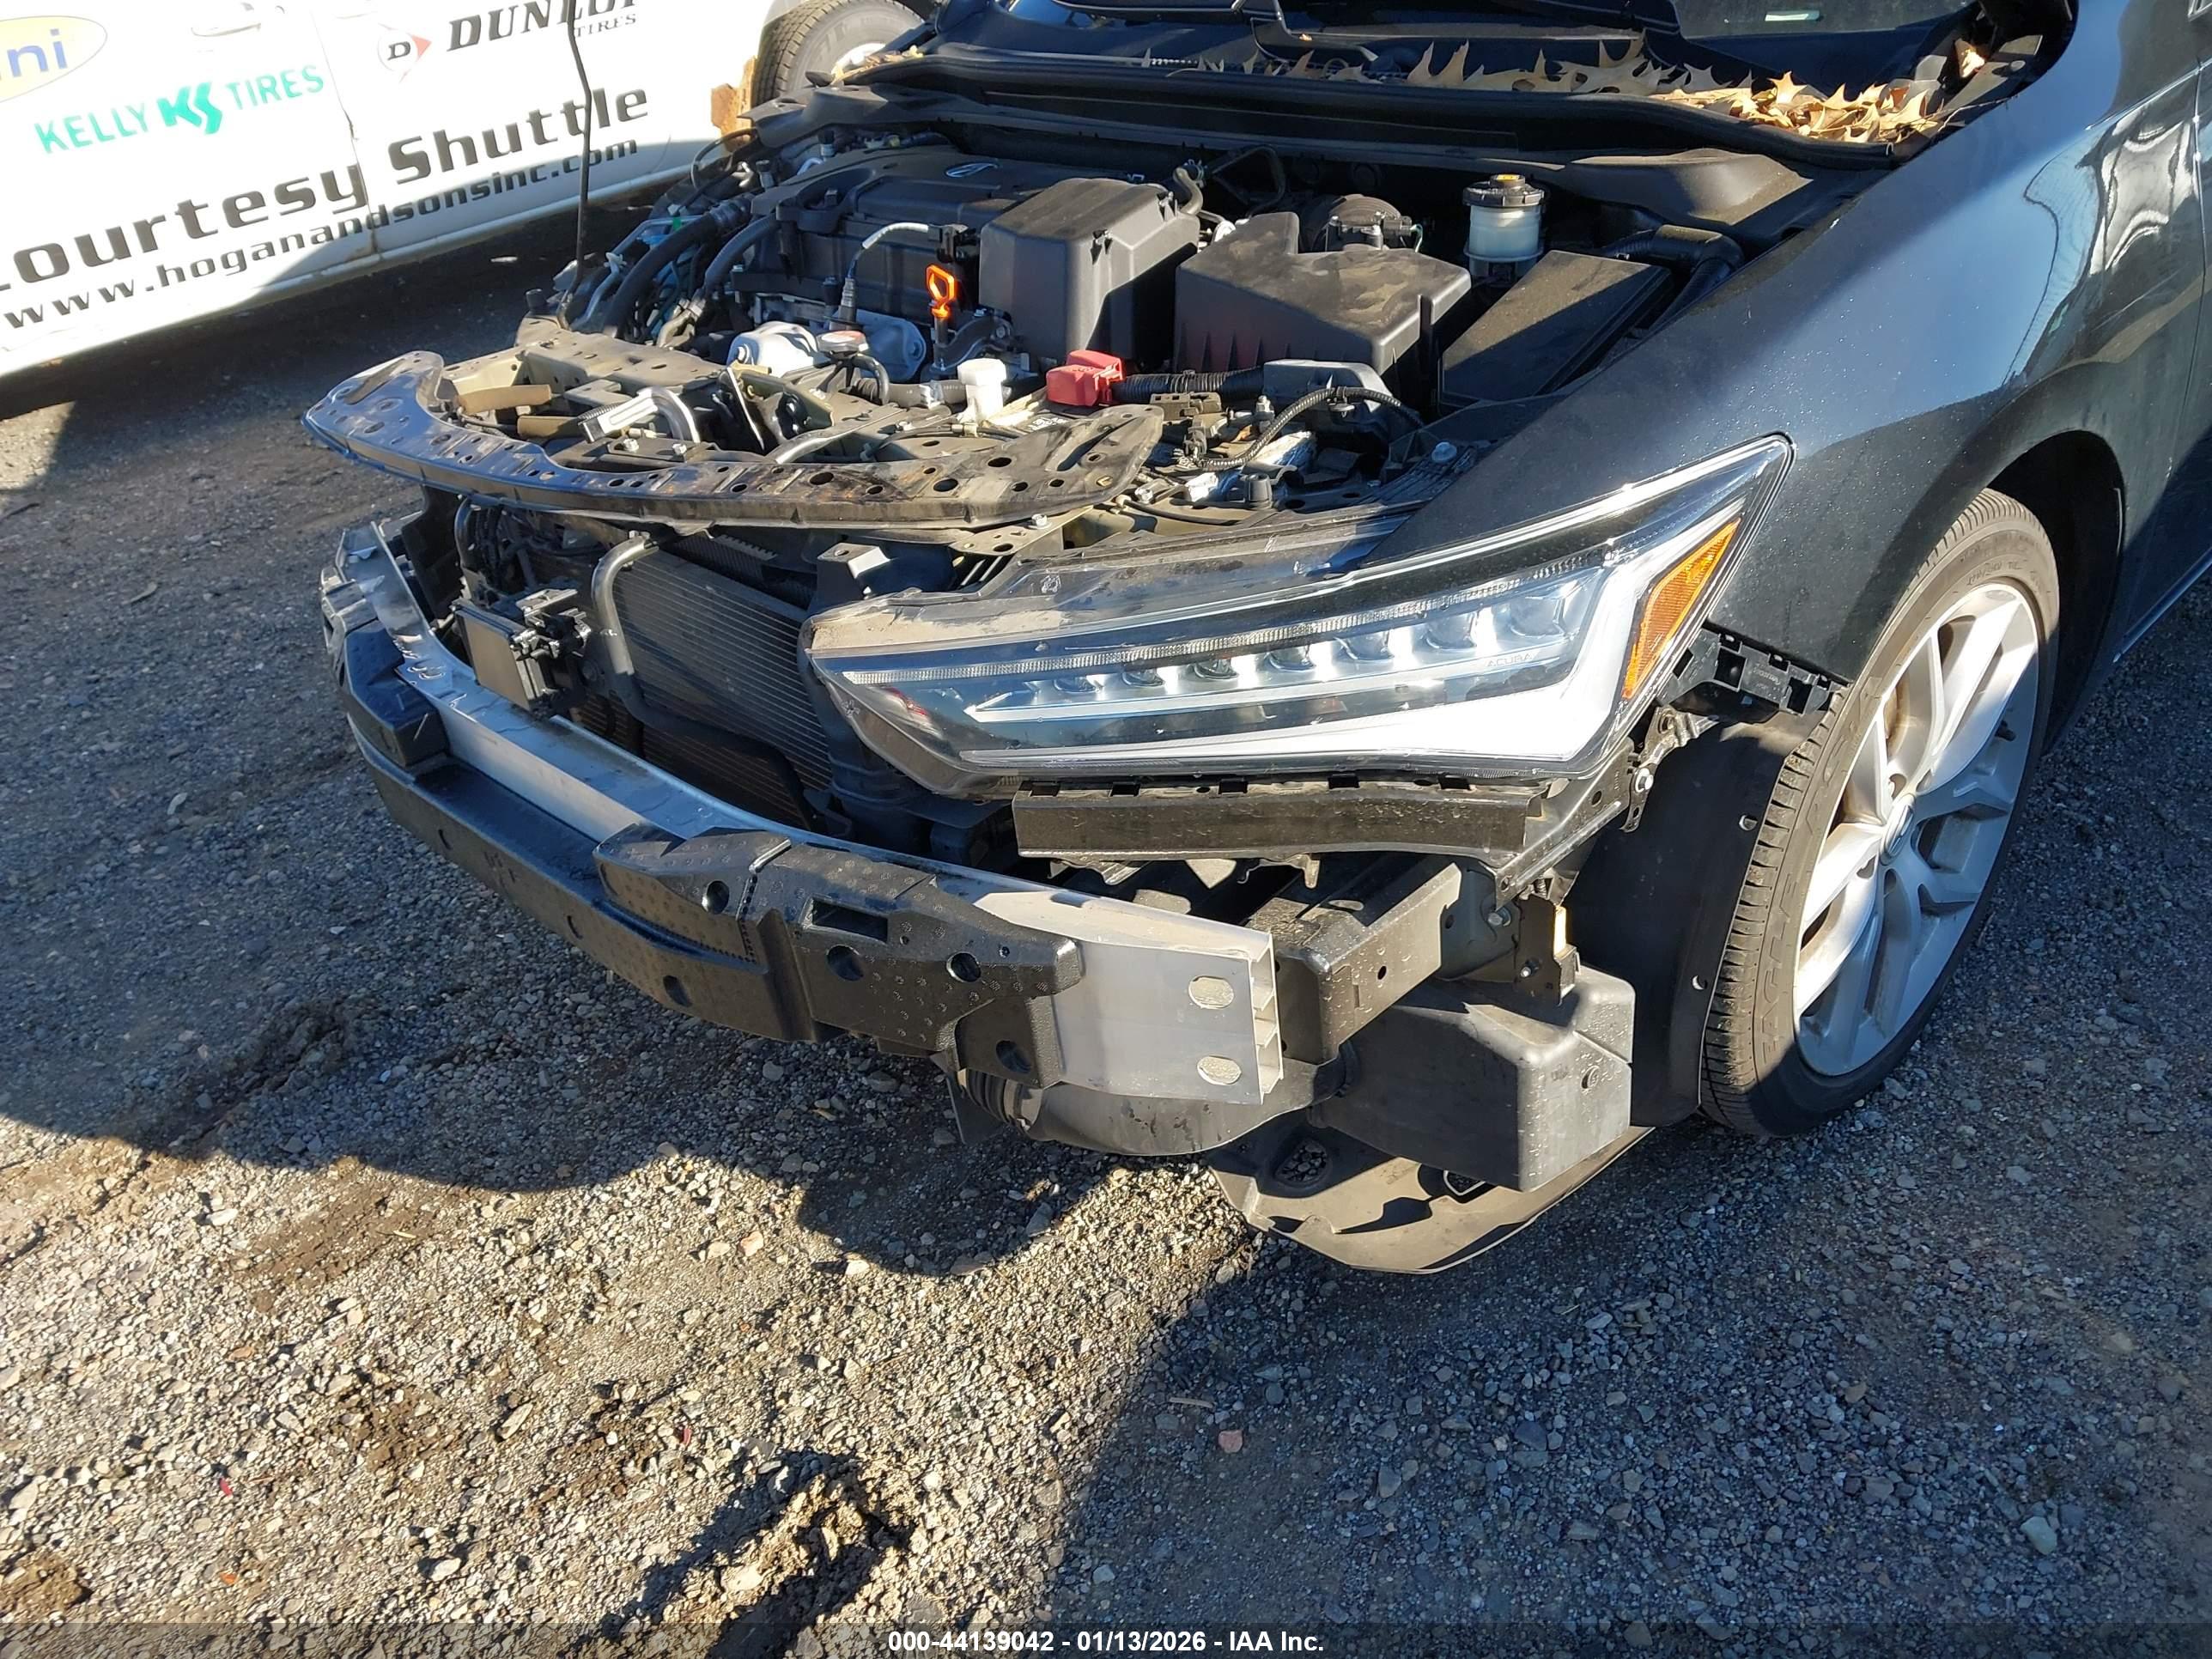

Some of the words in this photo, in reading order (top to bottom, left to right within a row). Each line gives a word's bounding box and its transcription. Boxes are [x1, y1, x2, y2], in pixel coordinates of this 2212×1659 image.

[0, 28, 68, 78] ni
[574, 13, 635, 37] TIRES
[34, 101, 149, 154] KELLY
[225, 64, 325, 110] TIRES
[0, 162, 368, 292] ourtesy
[387, 87, 648, 185] Shuttle
[3, 138, 638, 329] www.hoganandsonsinc.com
[1486, 653, 1533, 667] ACURA
